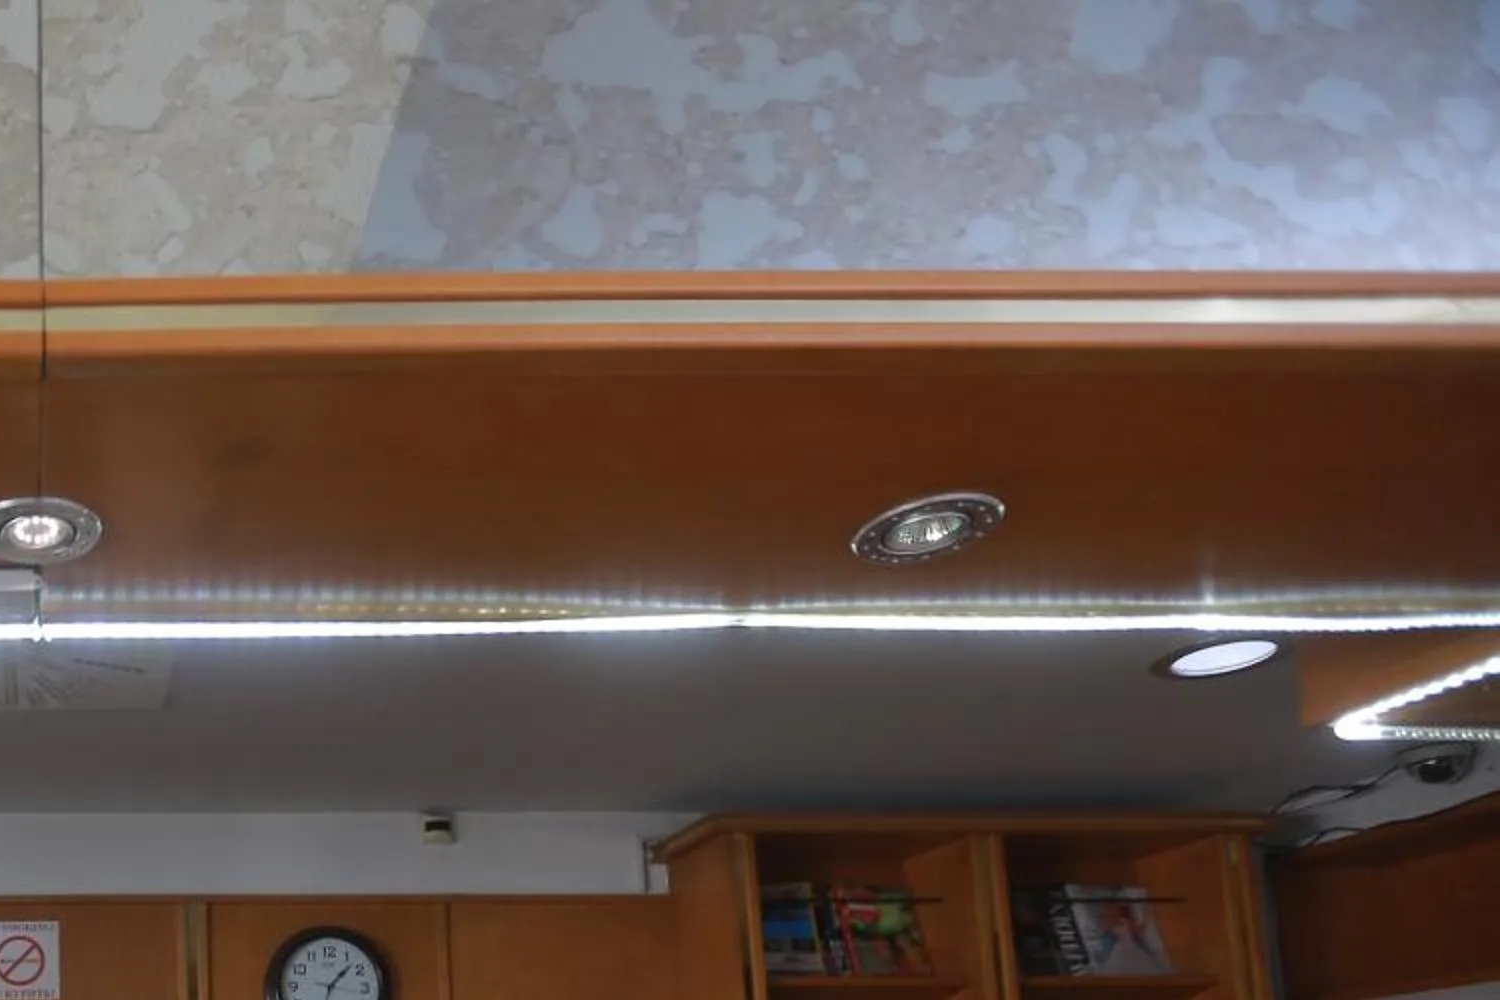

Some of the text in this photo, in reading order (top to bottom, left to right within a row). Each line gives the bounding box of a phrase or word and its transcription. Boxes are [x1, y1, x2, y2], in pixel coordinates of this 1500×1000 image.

[307, 951, 317, 961] 11
[323, 945, 337, 959] 12
[293, 963, 307, 975] 10
[355, 964, 365, 976] 2
[289, 982, 299, 992] 9
[360, 982, 370, 994] 3
